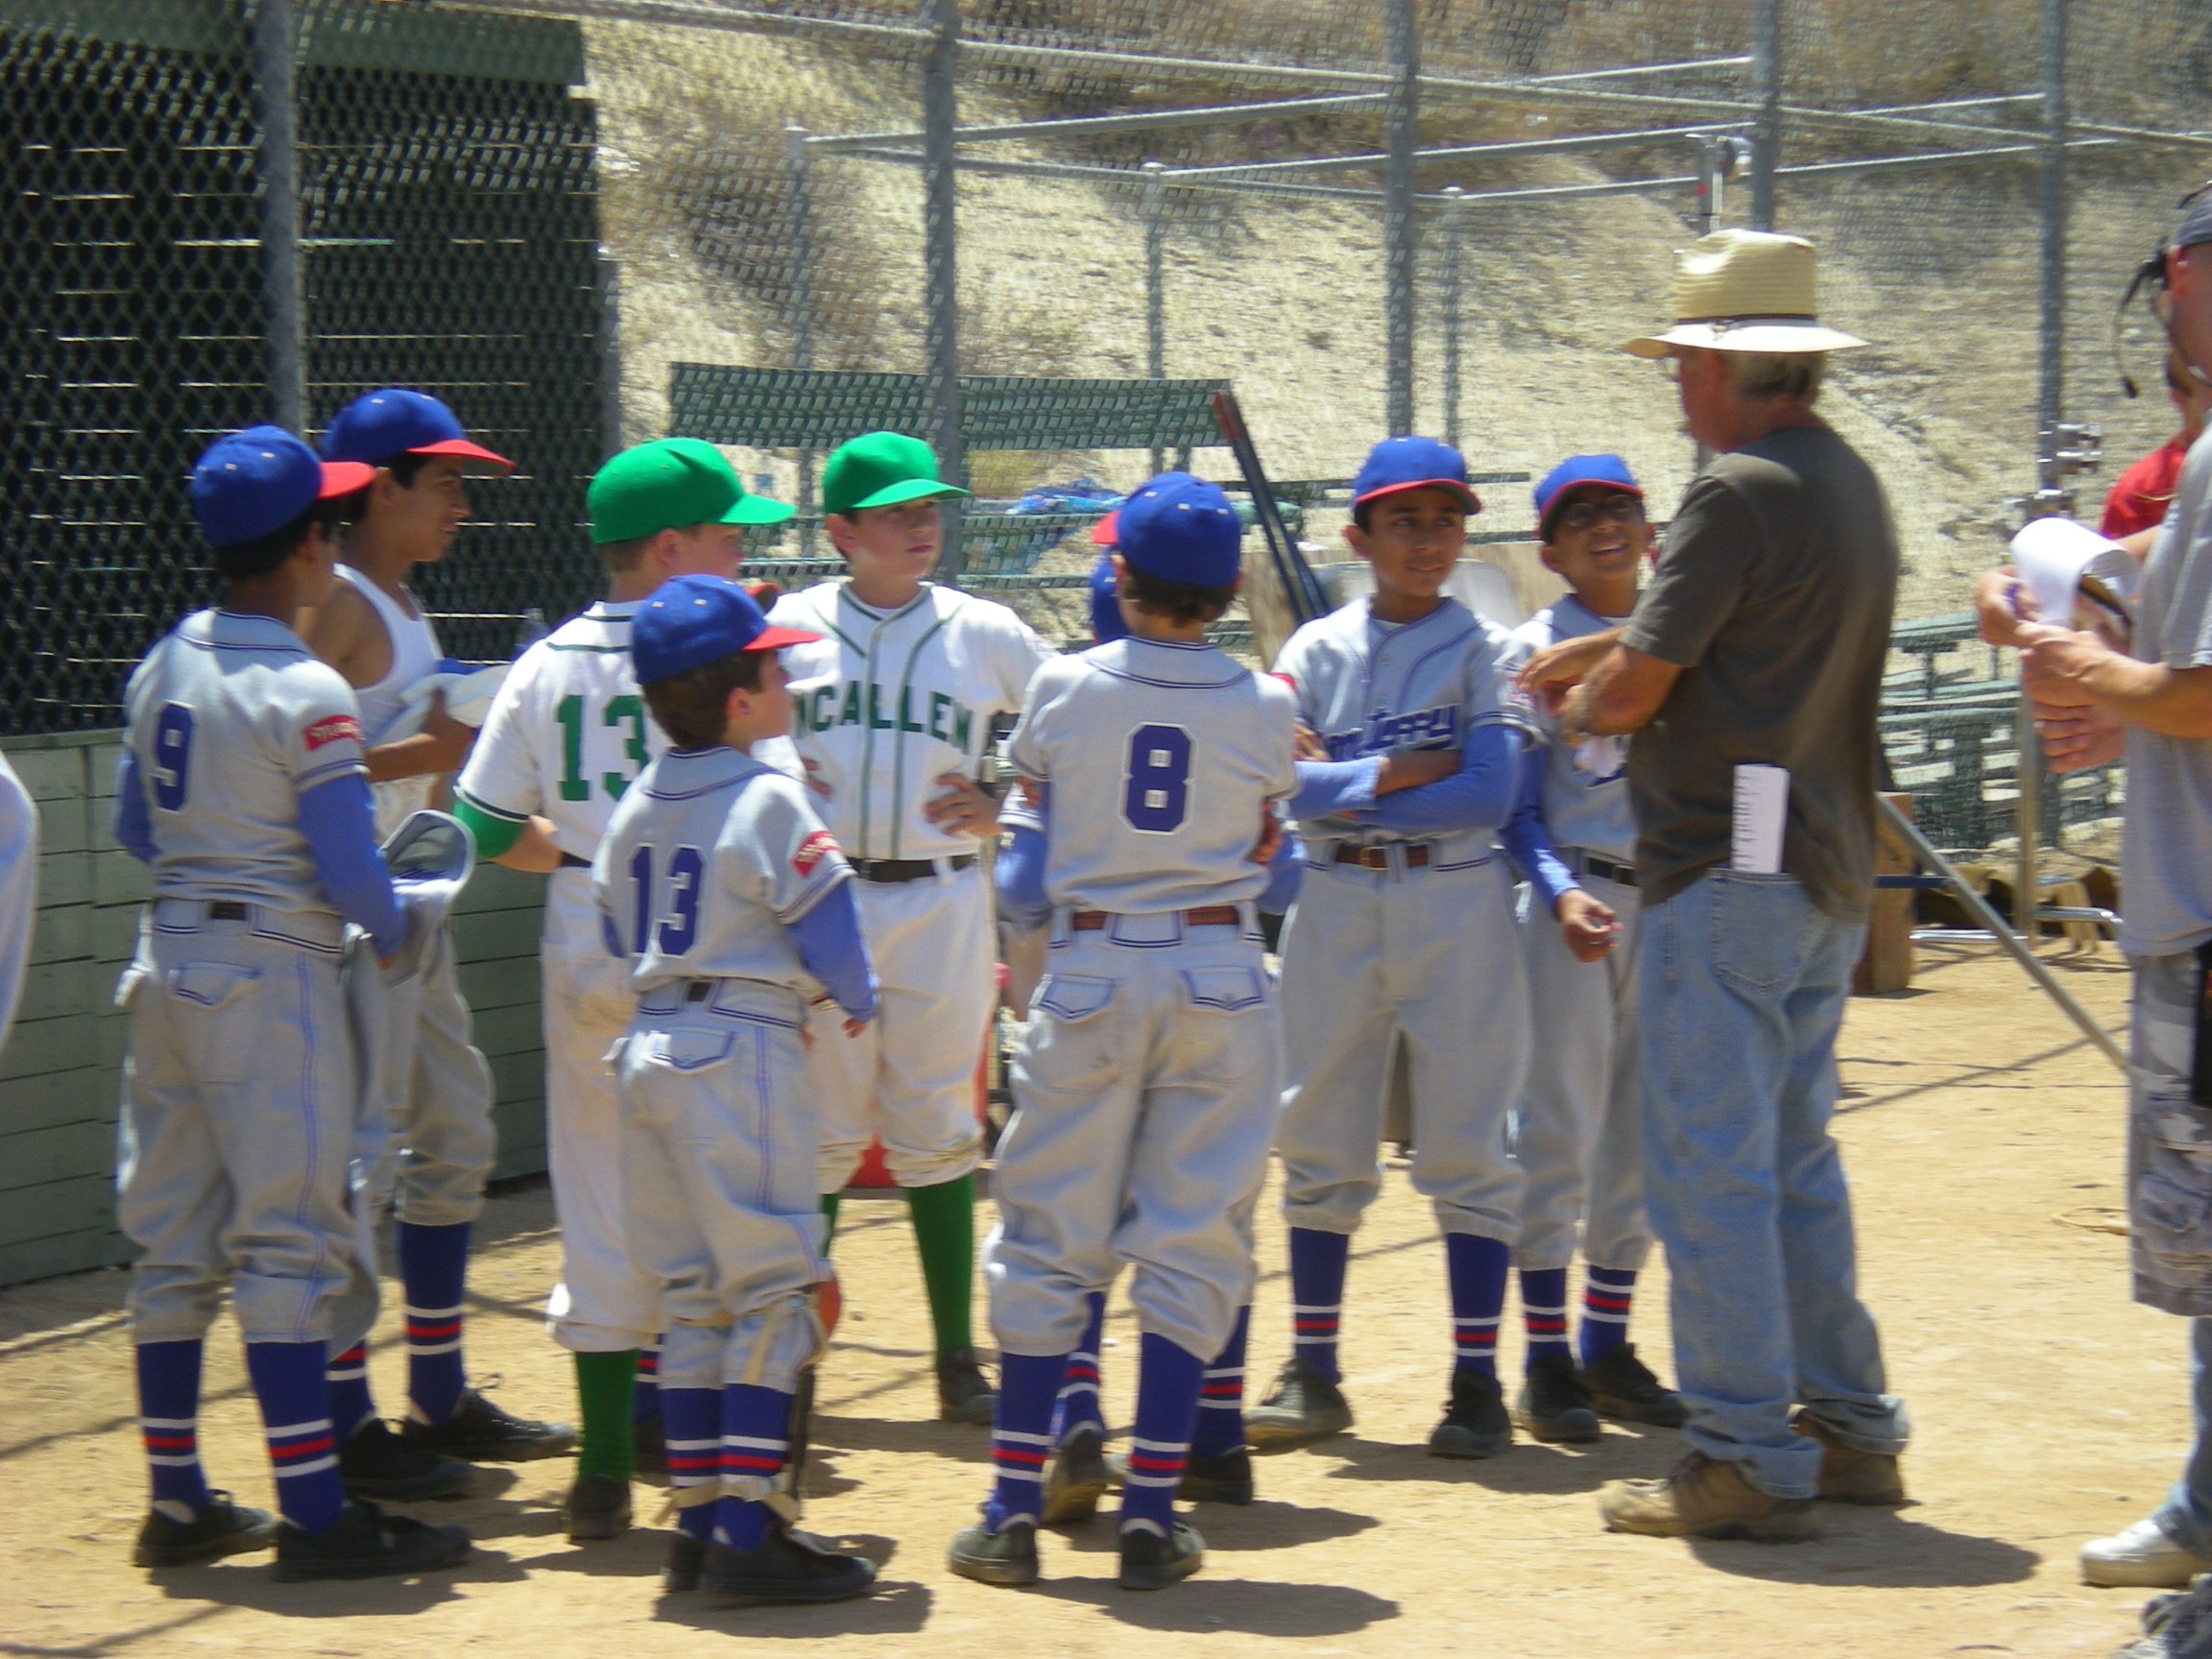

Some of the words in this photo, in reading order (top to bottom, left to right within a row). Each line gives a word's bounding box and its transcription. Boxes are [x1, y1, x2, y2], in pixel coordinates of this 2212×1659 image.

[154, 699, 195, 814] 9
[556, 694, 650, 802] 13
[1119, 721, 1197, 835] 8
[629, 842, 704, 958] 13
